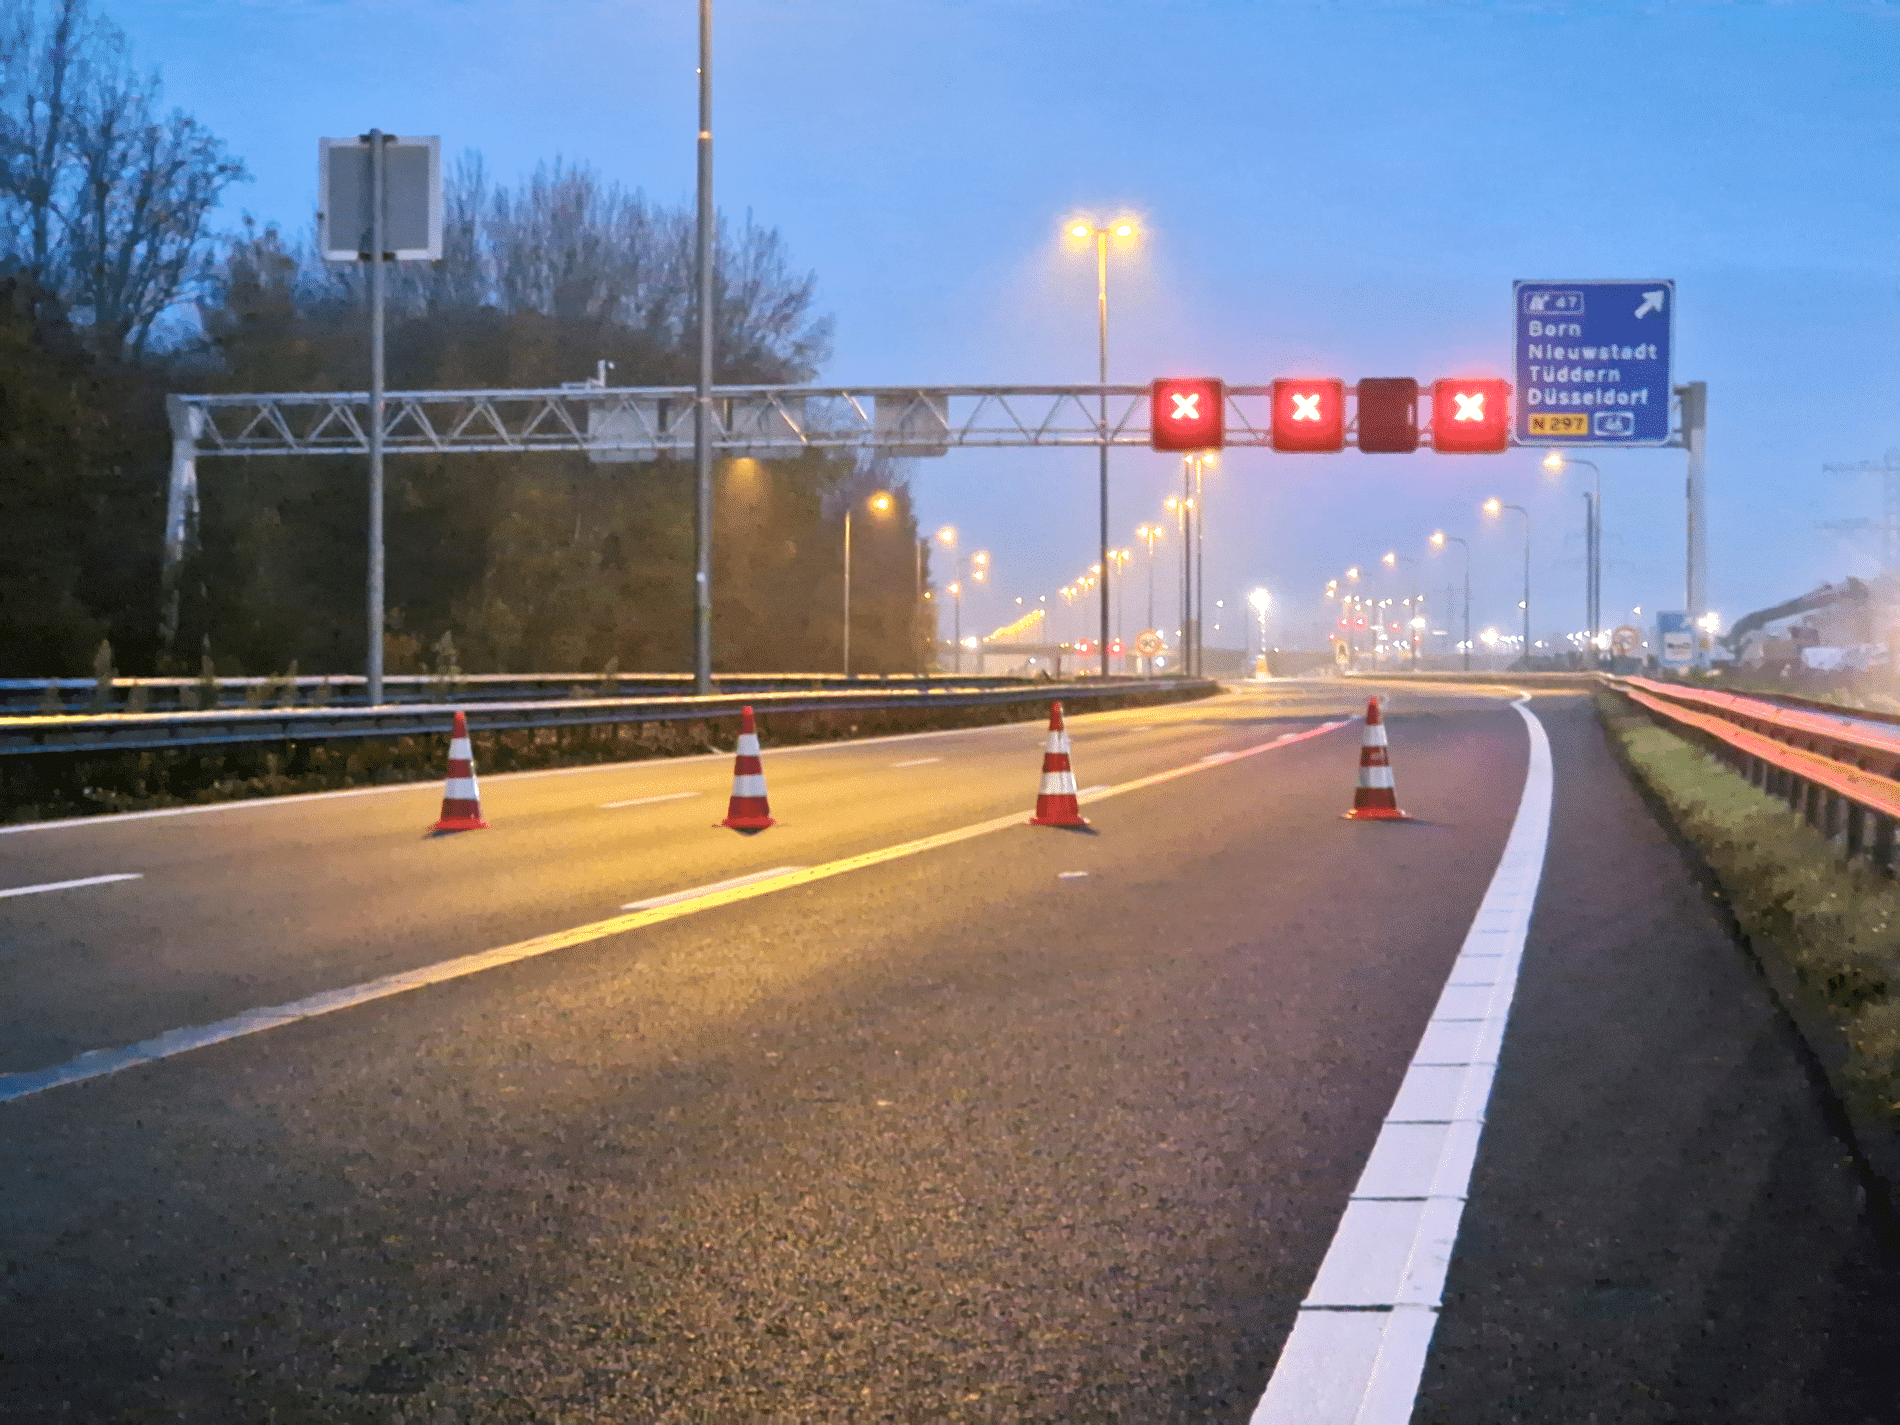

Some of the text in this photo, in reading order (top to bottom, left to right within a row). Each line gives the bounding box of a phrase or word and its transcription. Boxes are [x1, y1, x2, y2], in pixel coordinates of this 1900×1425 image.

[1529, 320, 1581, 337] Born
[1529, 343, 1657, 360] Nieuwstadt
[1529, 365, 1621, 382] Tüddern
[1528, 387, 1648, 405] Düsseldorf
